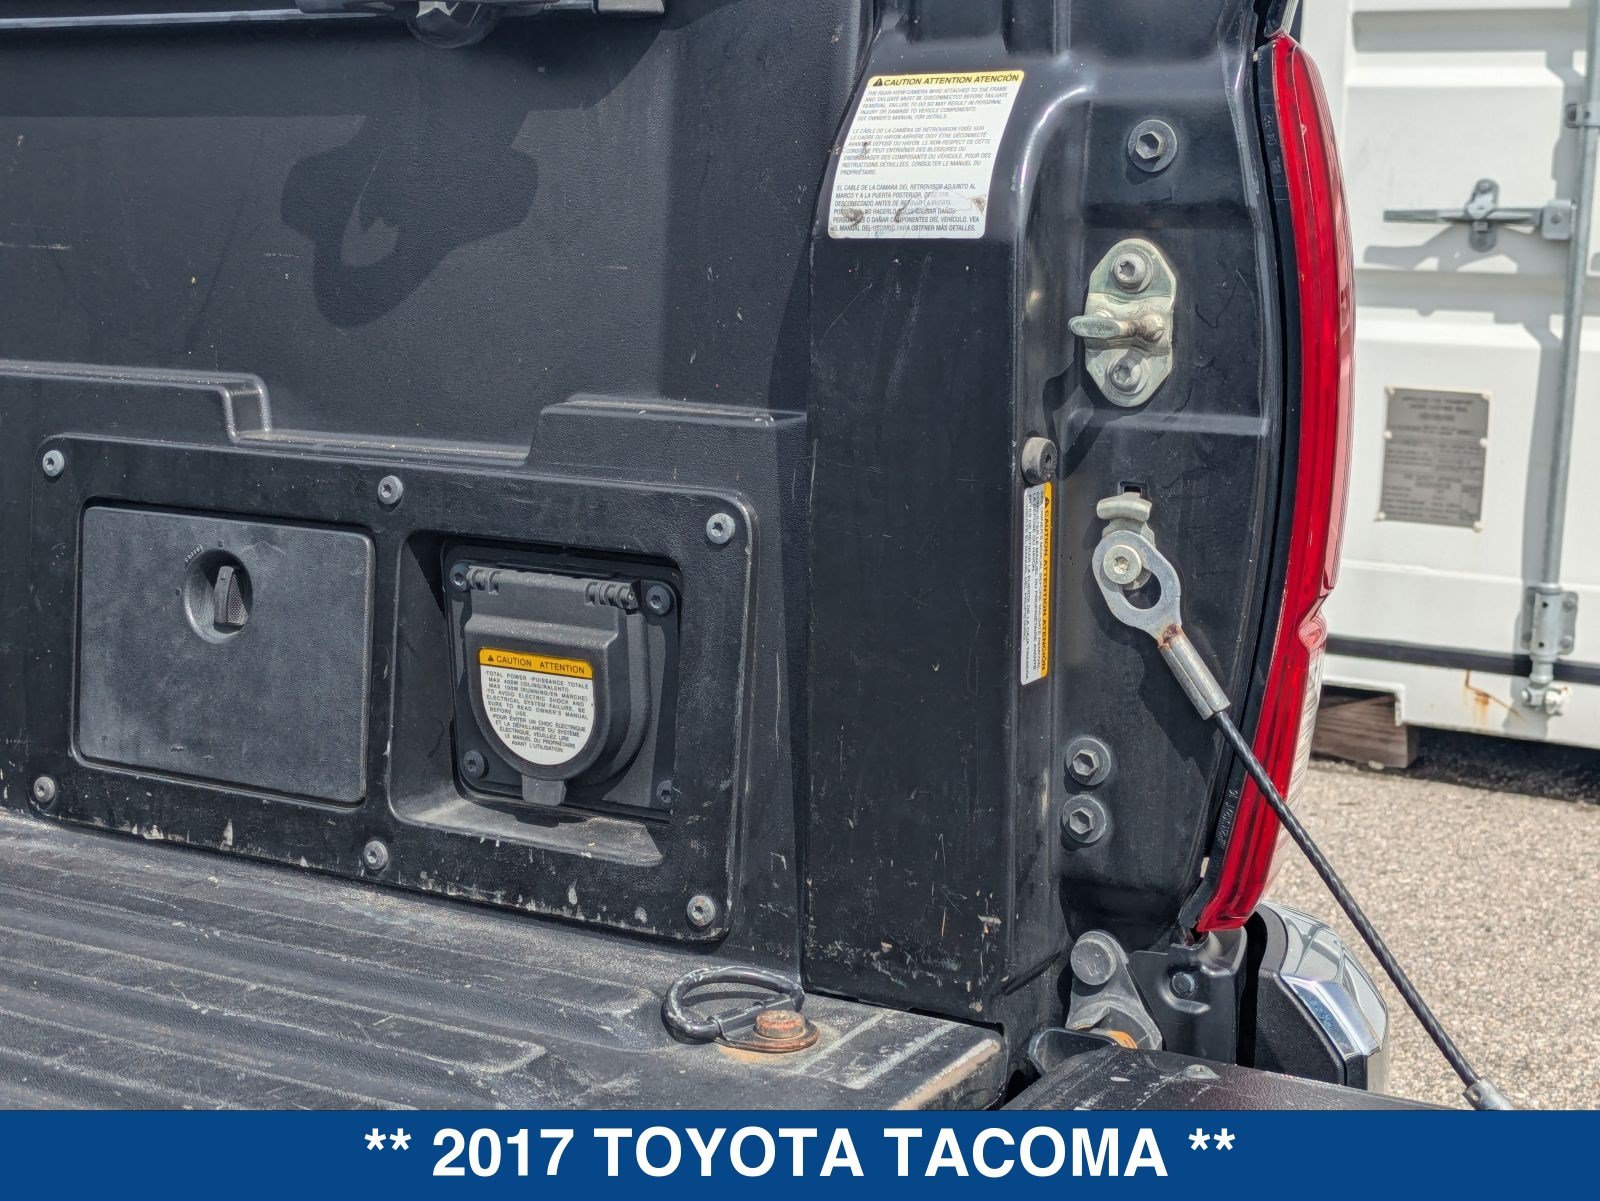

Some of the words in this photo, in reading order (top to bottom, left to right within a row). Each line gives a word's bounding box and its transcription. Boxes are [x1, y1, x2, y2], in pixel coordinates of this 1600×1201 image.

[884, 78, 922, 86] CAUTION
[974, 74, 1019, 83] ATENCIÓN
[497, 656, 531, 666] CAUTION
[540, 662, 585, 674] ATTENTION
[519, 693, 546, 701] ELECTRIC
